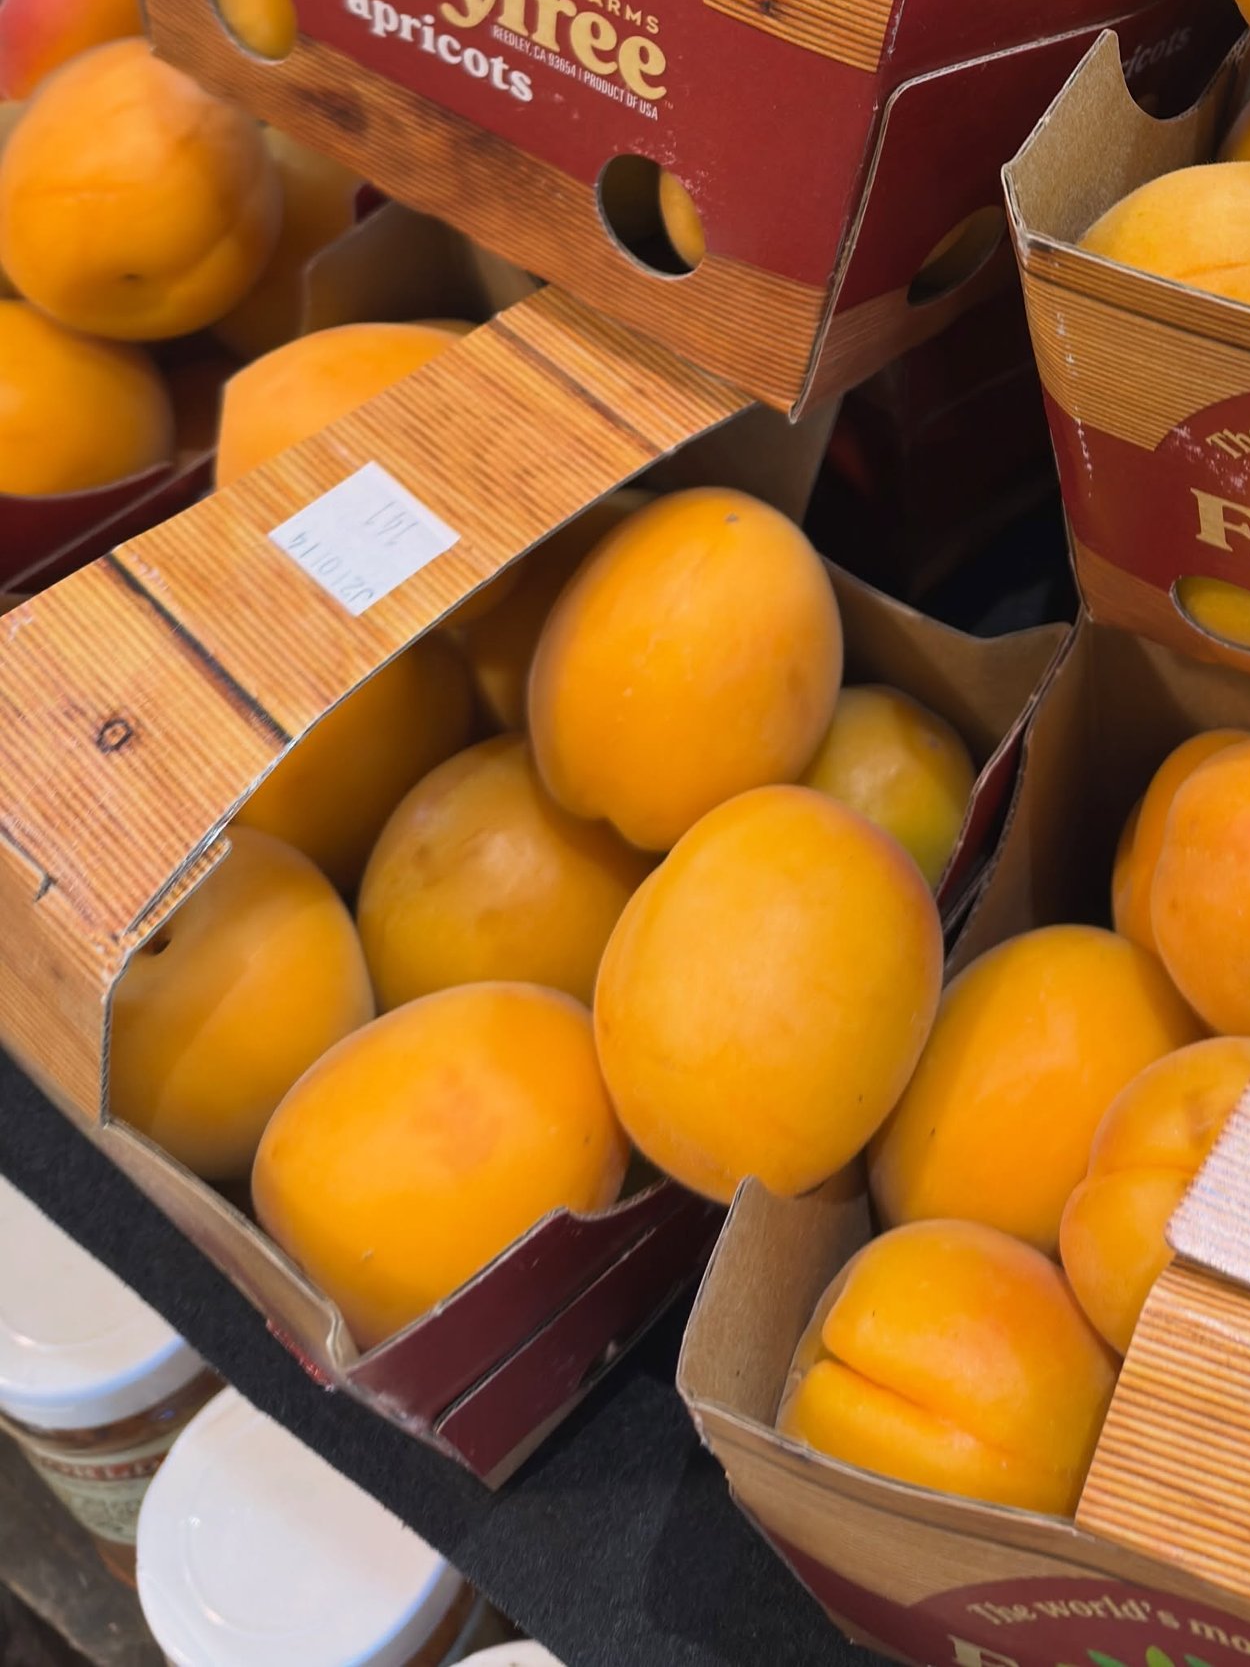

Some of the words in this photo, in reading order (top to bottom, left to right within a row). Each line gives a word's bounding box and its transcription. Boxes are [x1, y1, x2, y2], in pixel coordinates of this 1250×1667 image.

[532, 45, 547, 62] CA
[583, 70, 625, 104] PRODUCT
[626, 94, 639, 110] OF
[639, 100, 659, 122] USA
[363, 500, 420, 547] 141
[966, 1600, 1036, 1627] The
